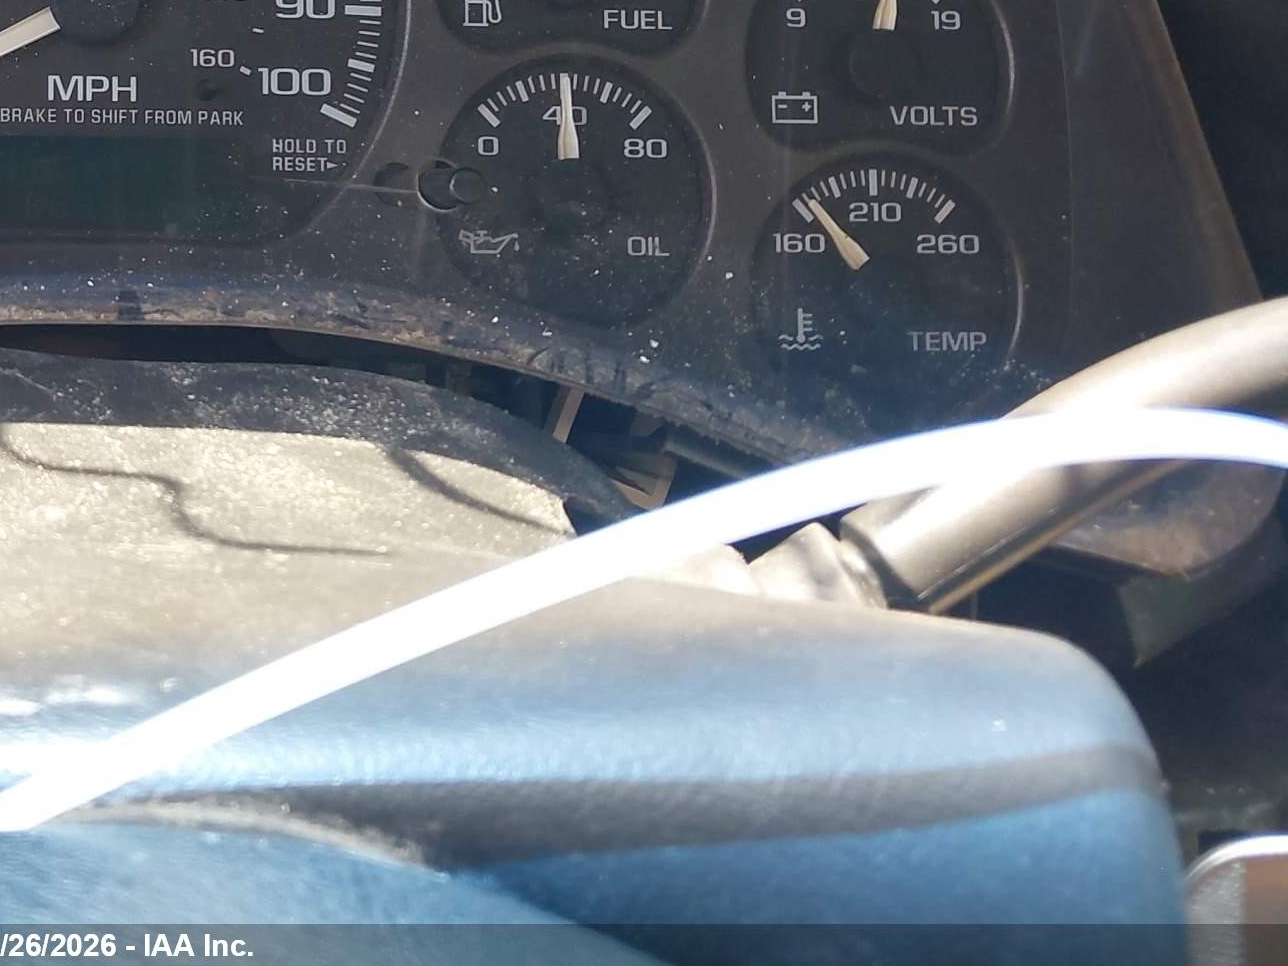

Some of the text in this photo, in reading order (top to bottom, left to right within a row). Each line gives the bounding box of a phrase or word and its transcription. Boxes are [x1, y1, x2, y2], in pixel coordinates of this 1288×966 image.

[603, 9, 672, 30] FUEL
[785, 8, 806, 28] 9
[931, 10, 961, 31] 19
[190, 49, 235, 68] 160
[47, 75, 137, 103] MPH
[257, 68, 331, 96] 100
[0, 108, 57, 124] BRAKE
[63, 109, 86, 124] TO
[90, 109, 138, 125] SHIFT
[144, 110, 192, 125] FROM
[197, 110, 244, 126] PARK
[542, 105, 587, 126] 40
[890, 105, 978, 127] VOLTS
[272, 139, 346, 155] HOLD TO
[478, 137, 499, 156] 0
[623, 138, 668, 159] 80
[272, 157, 327, 172] RESET
[849, 202, 902, 223] 210
[627, 236, 670, 257] OIL
[774, 233, 826, 253] 160
[916, 234, 980, 255] 260
[909, 330, 987, 352] TEMP
